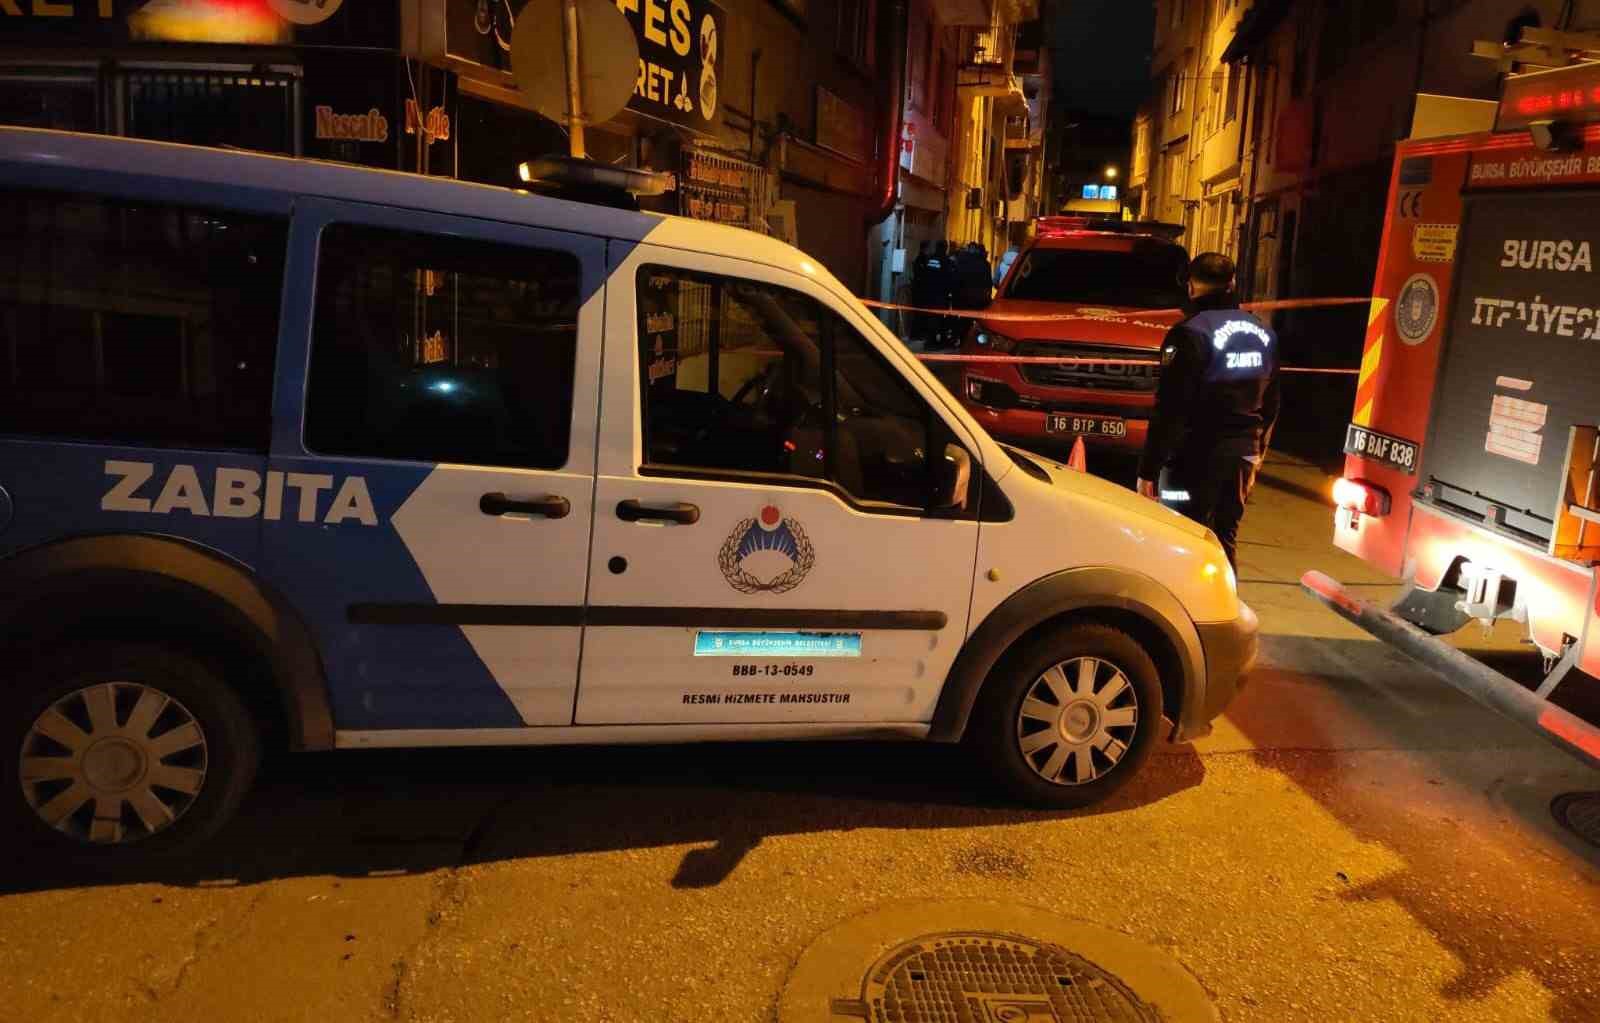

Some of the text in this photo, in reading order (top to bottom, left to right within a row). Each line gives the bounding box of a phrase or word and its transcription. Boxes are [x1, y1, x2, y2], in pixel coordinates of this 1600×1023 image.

[1472, 161, 1505, 179] BURSA
[1500, 239, 1593, 272] BURSA
[1054, 417, 1123, 434] 16 BTP 650
[1355, 430, 1414, 467] 16 BAF 838
[101, 459, 379, 526] ZABITA
[732, 664, 814, 677] BBB-13-0549
